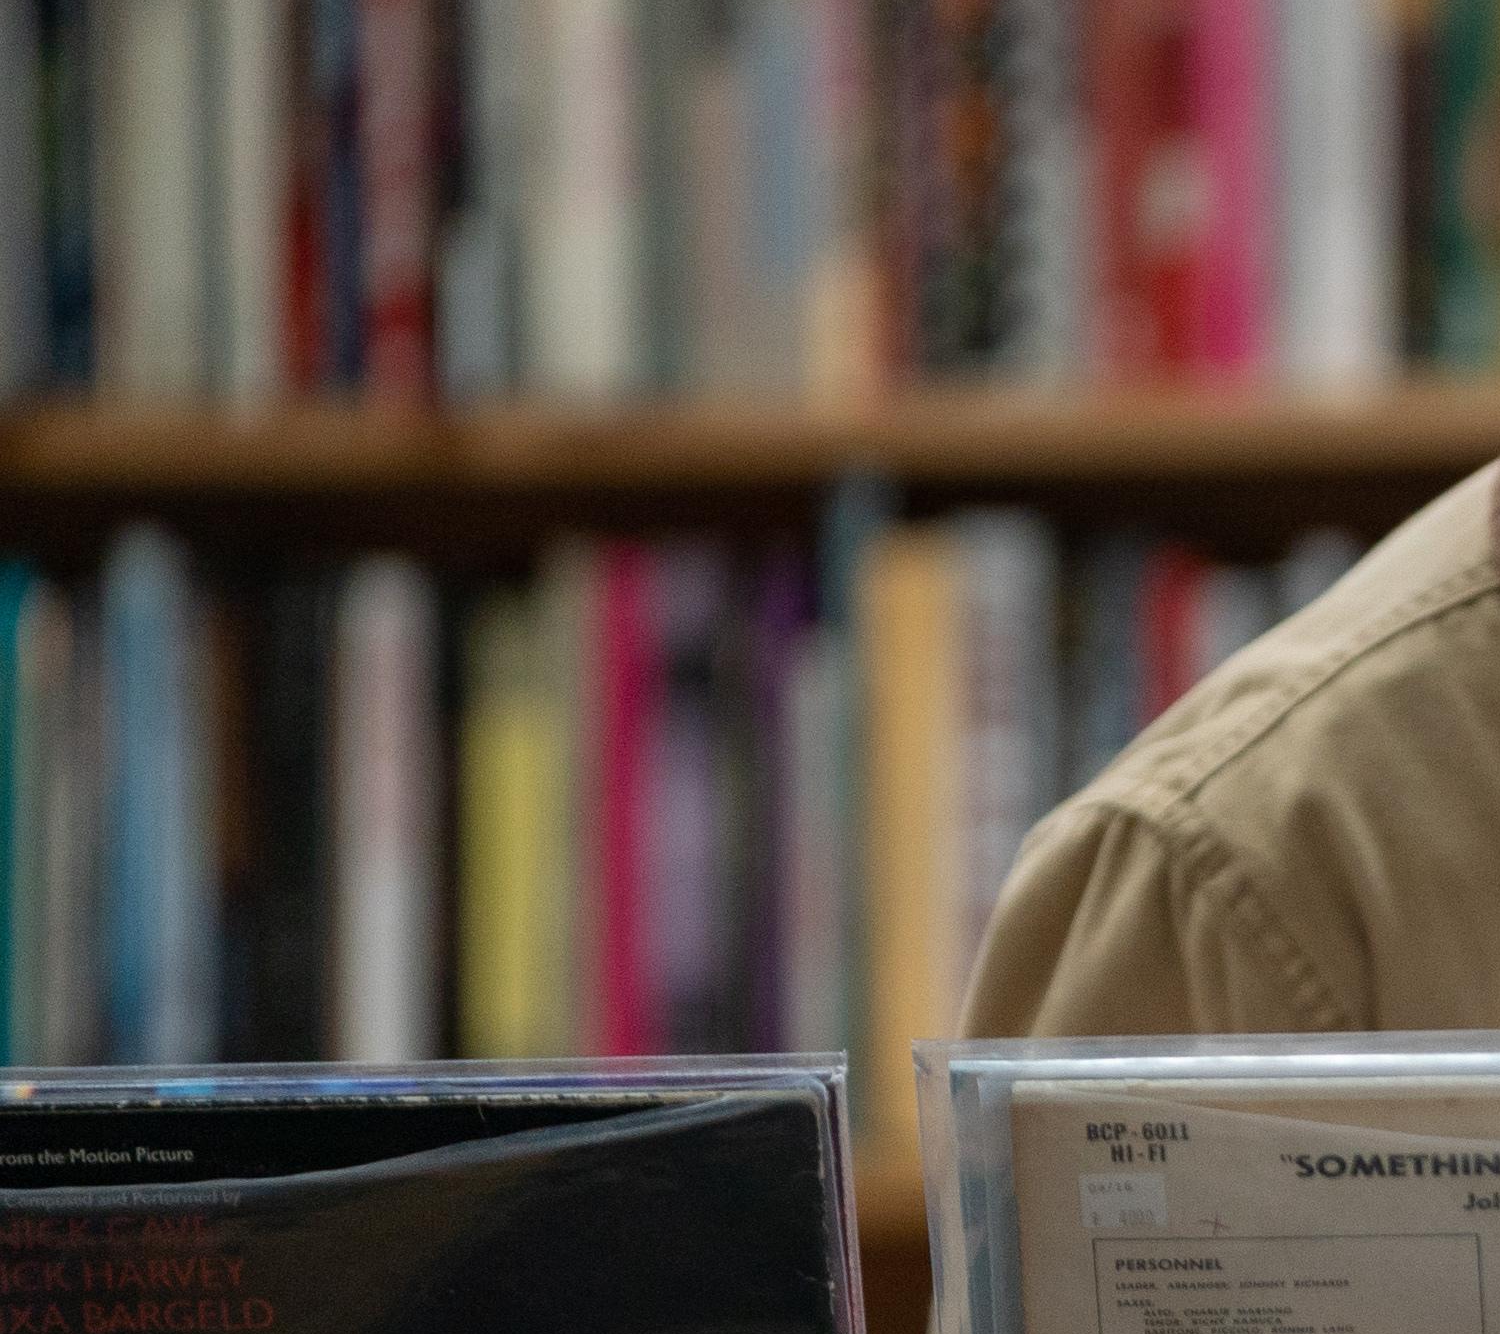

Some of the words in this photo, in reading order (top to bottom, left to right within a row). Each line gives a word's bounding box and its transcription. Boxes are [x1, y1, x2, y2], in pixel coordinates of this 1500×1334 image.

[37, 1148, 65, 1165] the
[70, 1147, 131, 1164] Motion
[136, 1146, 195, 1163] Picture
[3, 1193, 92, 1211] Composed
[98, 1192, 127, 1206] and
[133, 1190, 218, 1206] Performed
[221, 1190, 242, 1208] by
[83, 1256, 245, 1291] HARVEY
[1115, 1258, 1223, 1271] PERSONNEL
[82, 1297, 275, 1334] BARGELD
